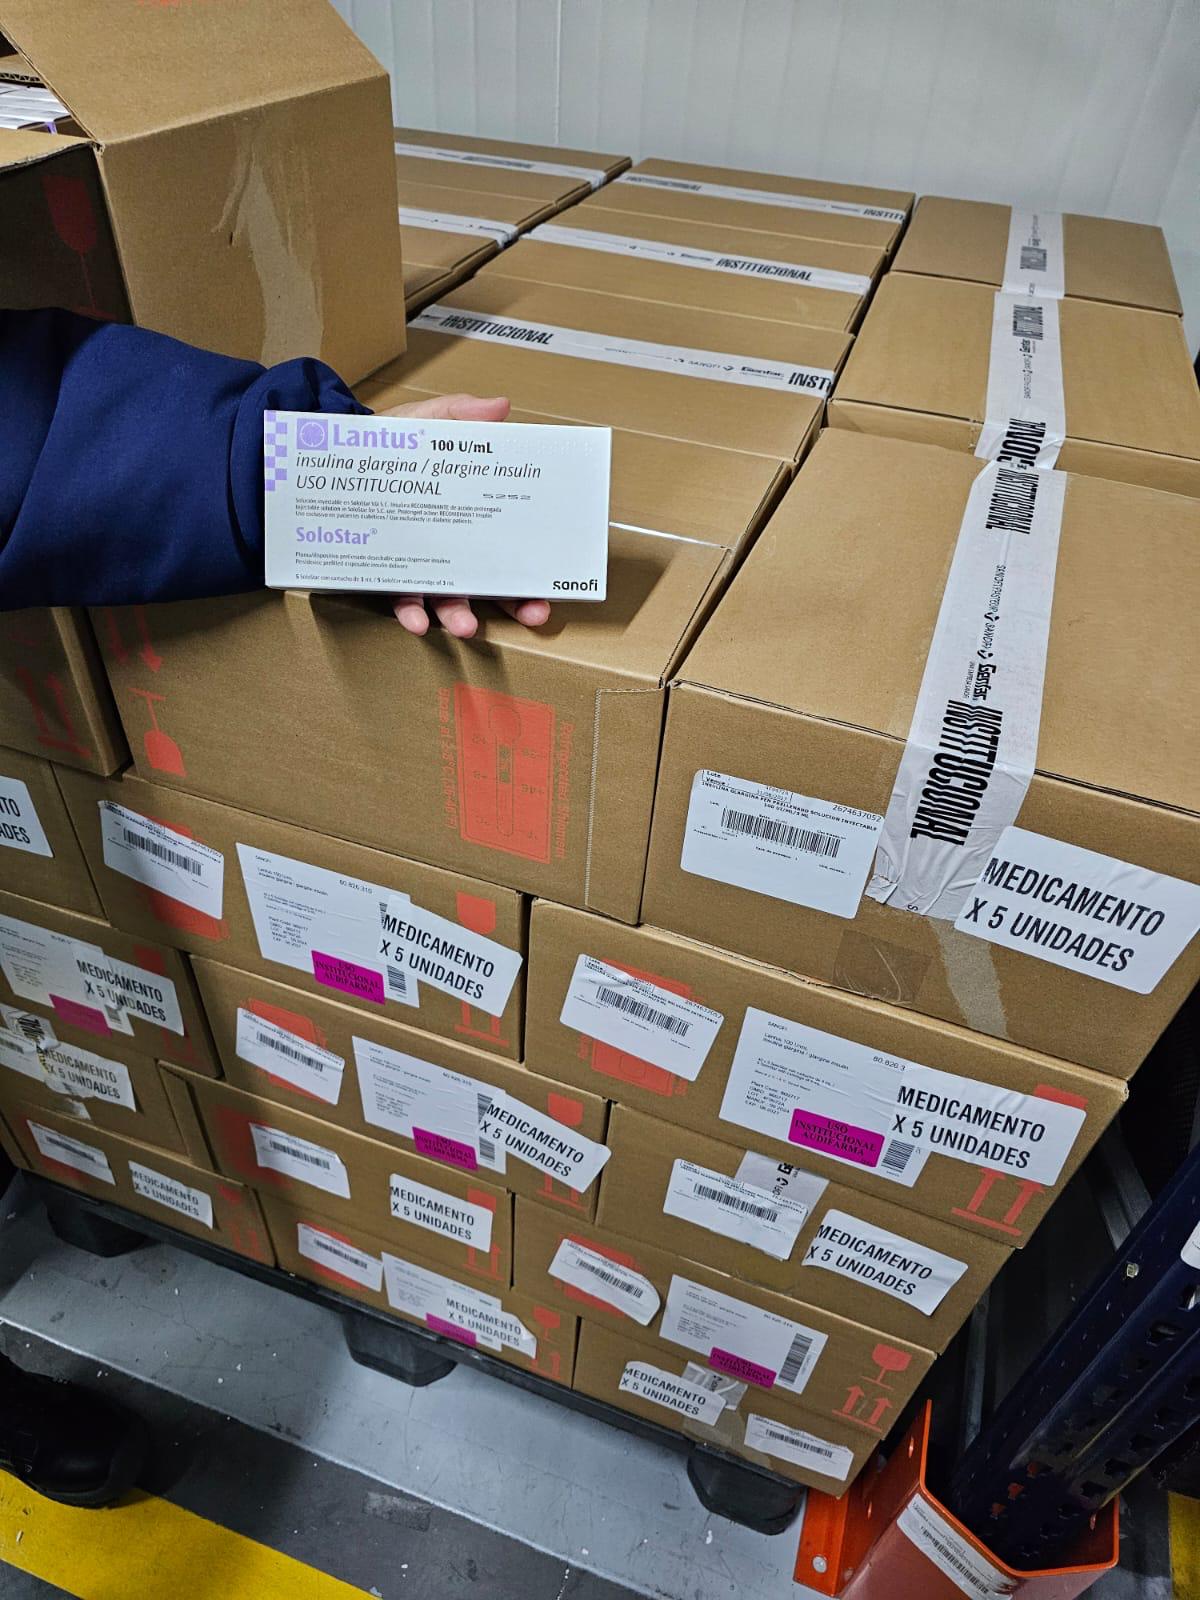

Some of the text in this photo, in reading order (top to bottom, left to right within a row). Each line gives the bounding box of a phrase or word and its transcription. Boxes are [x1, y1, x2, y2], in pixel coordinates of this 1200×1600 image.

[438, 314, 554, 346] INSTITUCIONAL
[296, 452, 541, 478] insulina glargina / glargine insulin
[431, 440, 454, 451] 100
[458, 441, 493, 454] U/mL
[296, 475, 442, 496] USO INSTITUCIONAL
[985, 467, 1040, 535] INSTITUCIONAL
[552, 579, 598, 592] sanofi
[910, 699, 1003, 846] INSTITUCIONAL
[832, 805, 881, 822] 2674637052
[841, 818, 878, 831] INYECTABLE
[982, 857, 1165, 936] MEDICAMENTO
[383, 913, 494, 978] MEDICAMENTO
[965, 897, 1135, 972] X 5 UNIDADES
[76, 959, 162, 1003] MEDICAMENTO
[379, 939, 484, 1000] X 5 UNIDADES
[85, 980, 93, 994] X
[98, 986, 105, 998] 5
[68, 1072, 120, 1099] UNIDADES
[827, 1120, 848, 1134] USO
[897, 1086, 1046, 1142] MEDICAMENTO
[480, 1120, 572, 1177] X 5 UNIDADES
[486, 1103, 584, 1164] MEDICAMENTO
[795, 1119, 876, 1150] INSTITUCIONAL
[802, 1133, 864, 1156] AUDIFARMA
[892, 1114, 1030, 1169] X 5 UNIDADES
[391, 1186, 475, 1226] MEDICAMENTO
[392, 1201, 471, 1240] X 5 UNIDADES
[806, 1246, 917, 1296] X 5 UNIDADES
[816, 1225, 932, 1280] MEDICAMENTO
[446, 1298, 521, 1335] MEDICAMENTO
[449, 1311, 455, 1320] X
[468, 1319, 519, 1347] UNIDADES
[621, 1378, 700, 1415] X 5 UNIDADES
[624, 1368, 706, 1406] MEDICAMENTO
